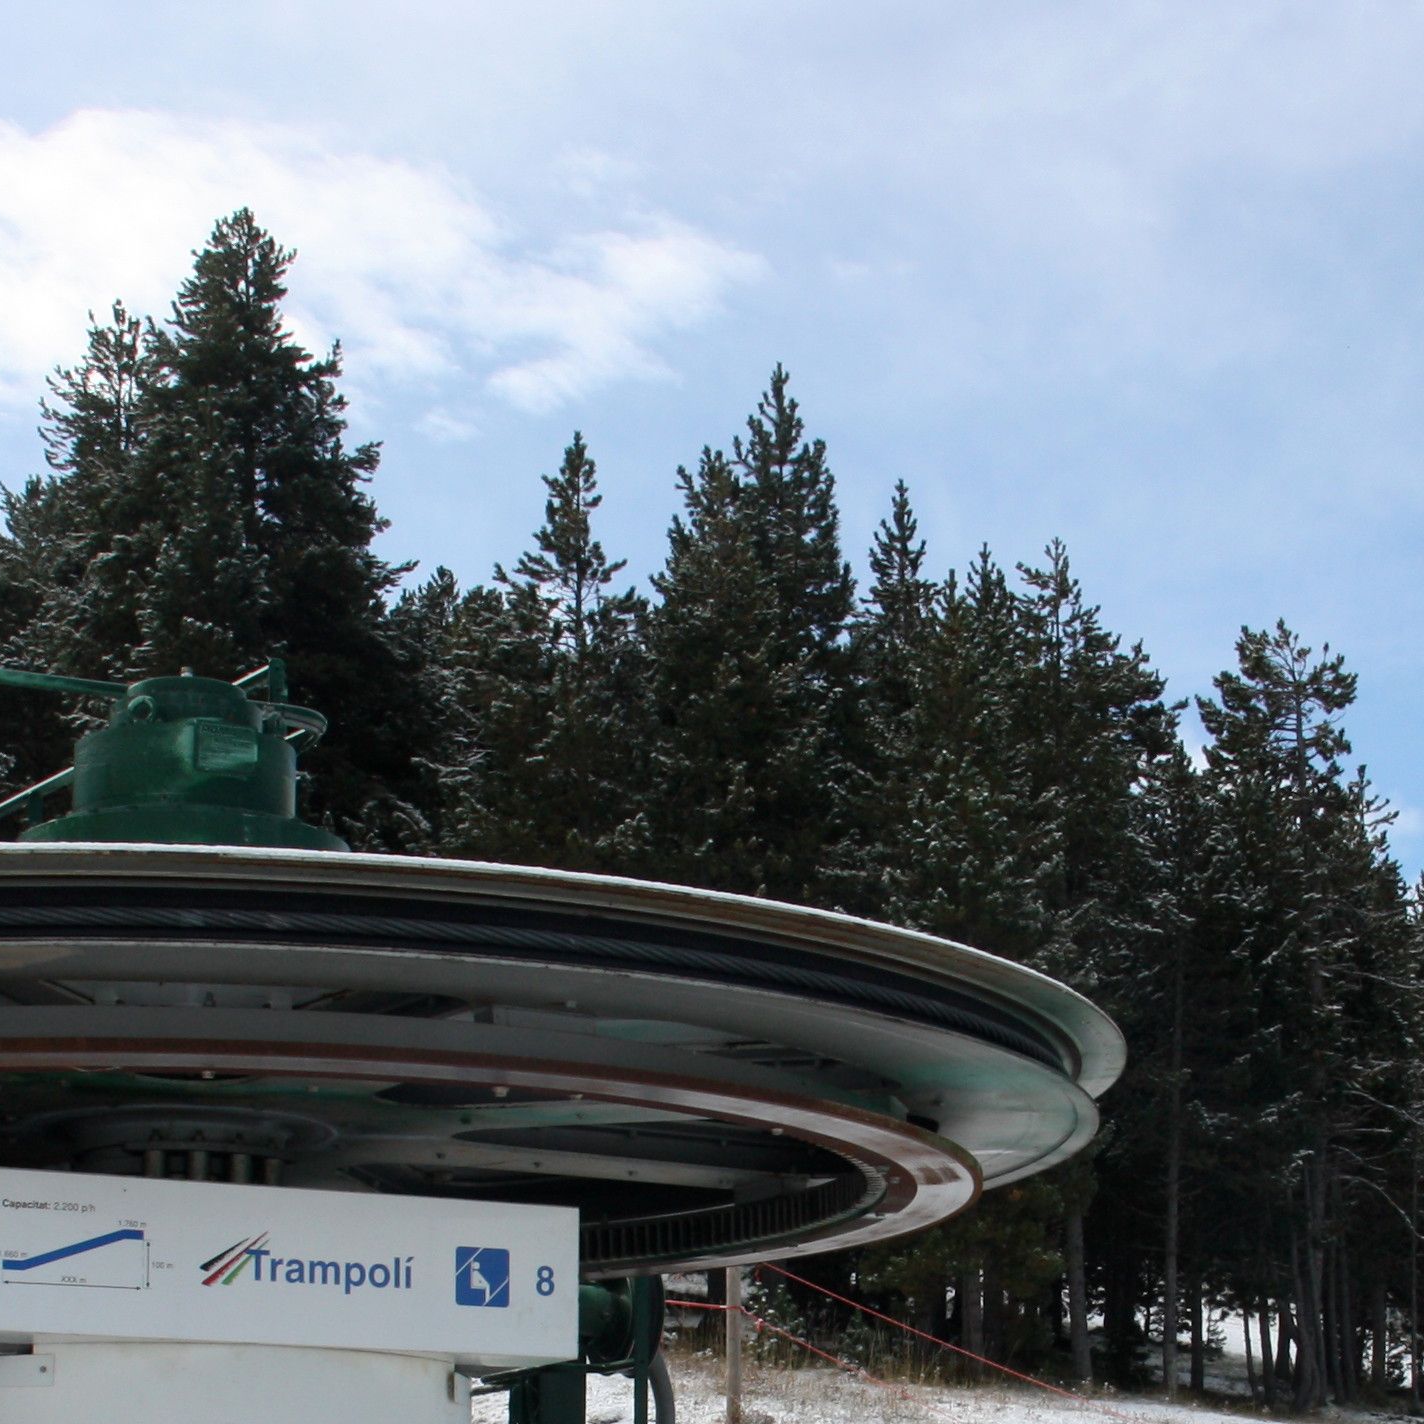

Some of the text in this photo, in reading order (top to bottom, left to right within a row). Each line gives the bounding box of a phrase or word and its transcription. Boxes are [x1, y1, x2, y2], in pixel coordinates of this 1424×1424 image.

[2, 1198, 51, 1210] Capacitat:
[53, 1202, 78, 1212] 2.200
[245, 1249, 414, 1294] Trampolí
[536, 1266, 555, 1296] 8
